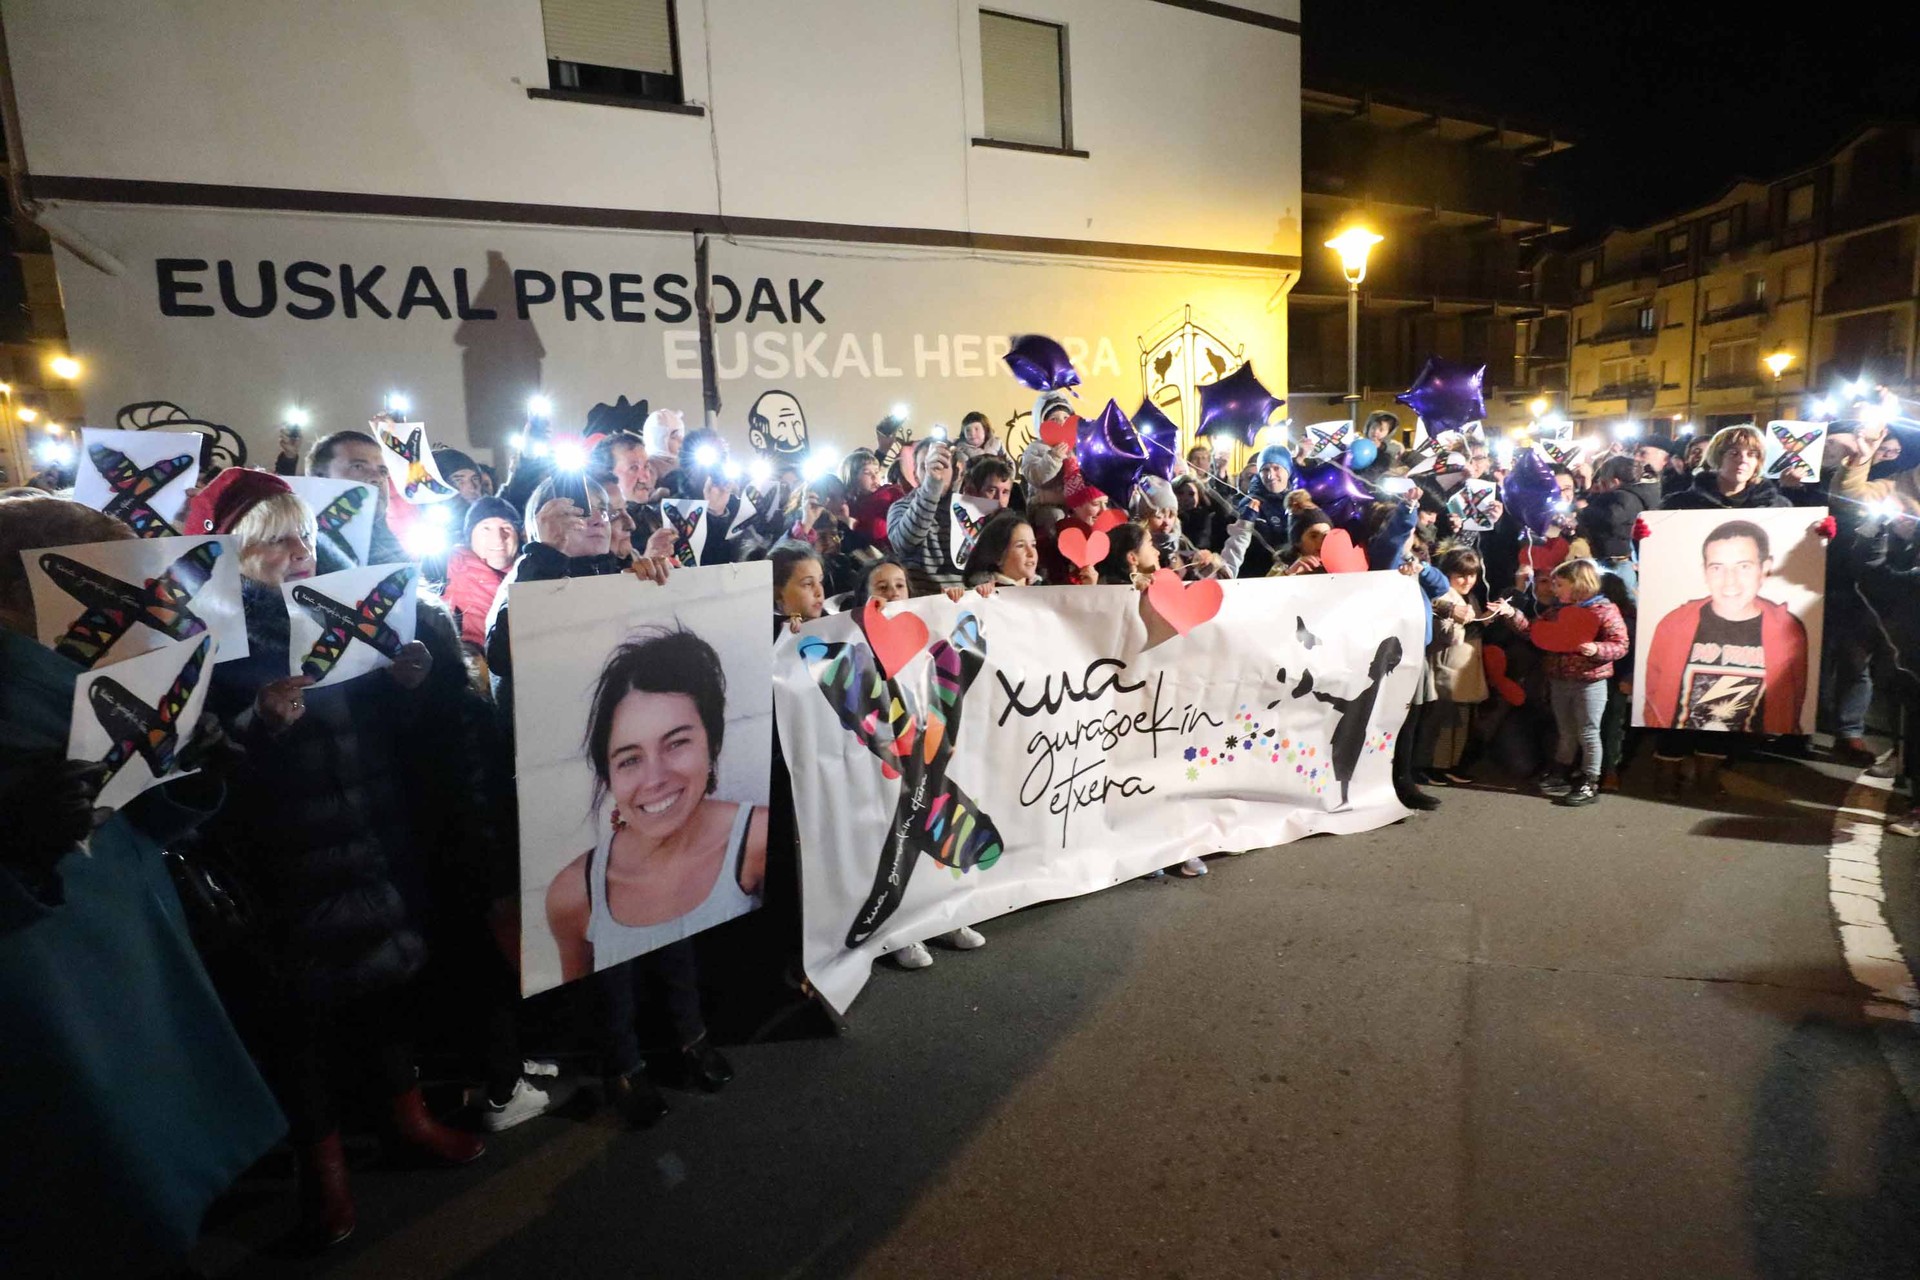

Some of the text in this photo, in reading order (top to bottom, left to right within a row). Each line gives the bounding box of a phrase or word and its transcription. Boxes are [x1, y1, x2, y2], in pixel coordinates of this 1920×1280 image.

[155, 258, 826, 324] EUSKAL PRESOAK
[663, 330, 1121, 380] EUSKAL HERRA
[996, 658, 1147, 727] xua
[1020, 671, 1224, 807] gurasoekin
[1050, 757, 1155, 848] etxera
